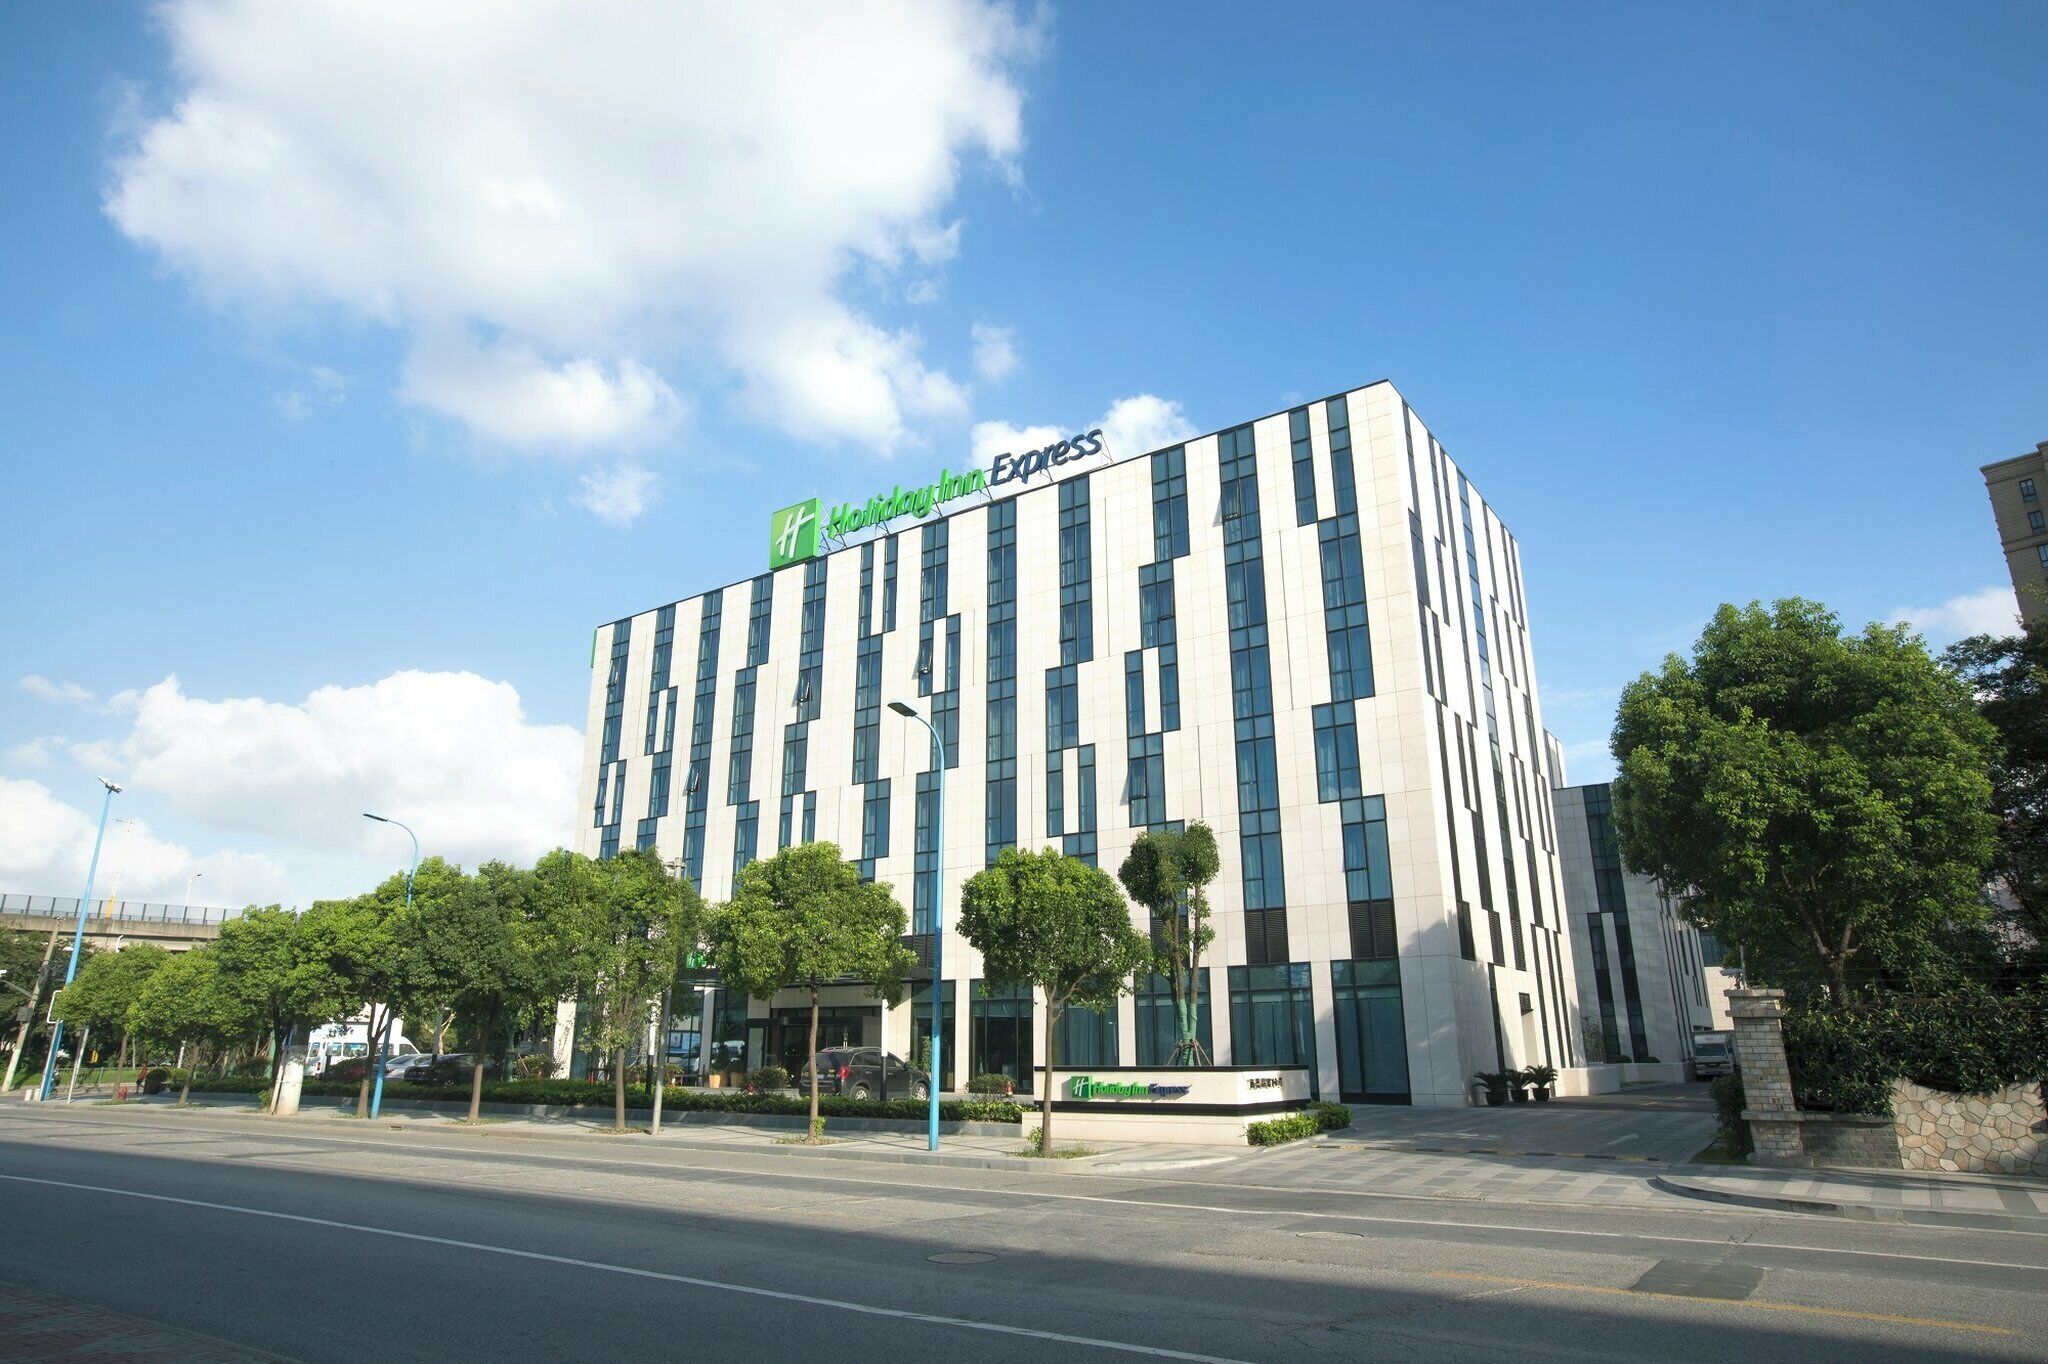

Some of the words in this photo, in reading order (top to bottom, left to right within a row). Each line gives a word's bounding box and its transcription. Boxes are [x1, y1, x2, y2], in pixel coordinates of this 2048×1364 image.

[826, 484, 935, 538] Holiday
[937, 469, 985, 503] Inn
[990, 429, 1103, 485] Express
[1093, 1082, 1132, 1096] Holiday
[1131, 1081, 1149, 1095] Inn
